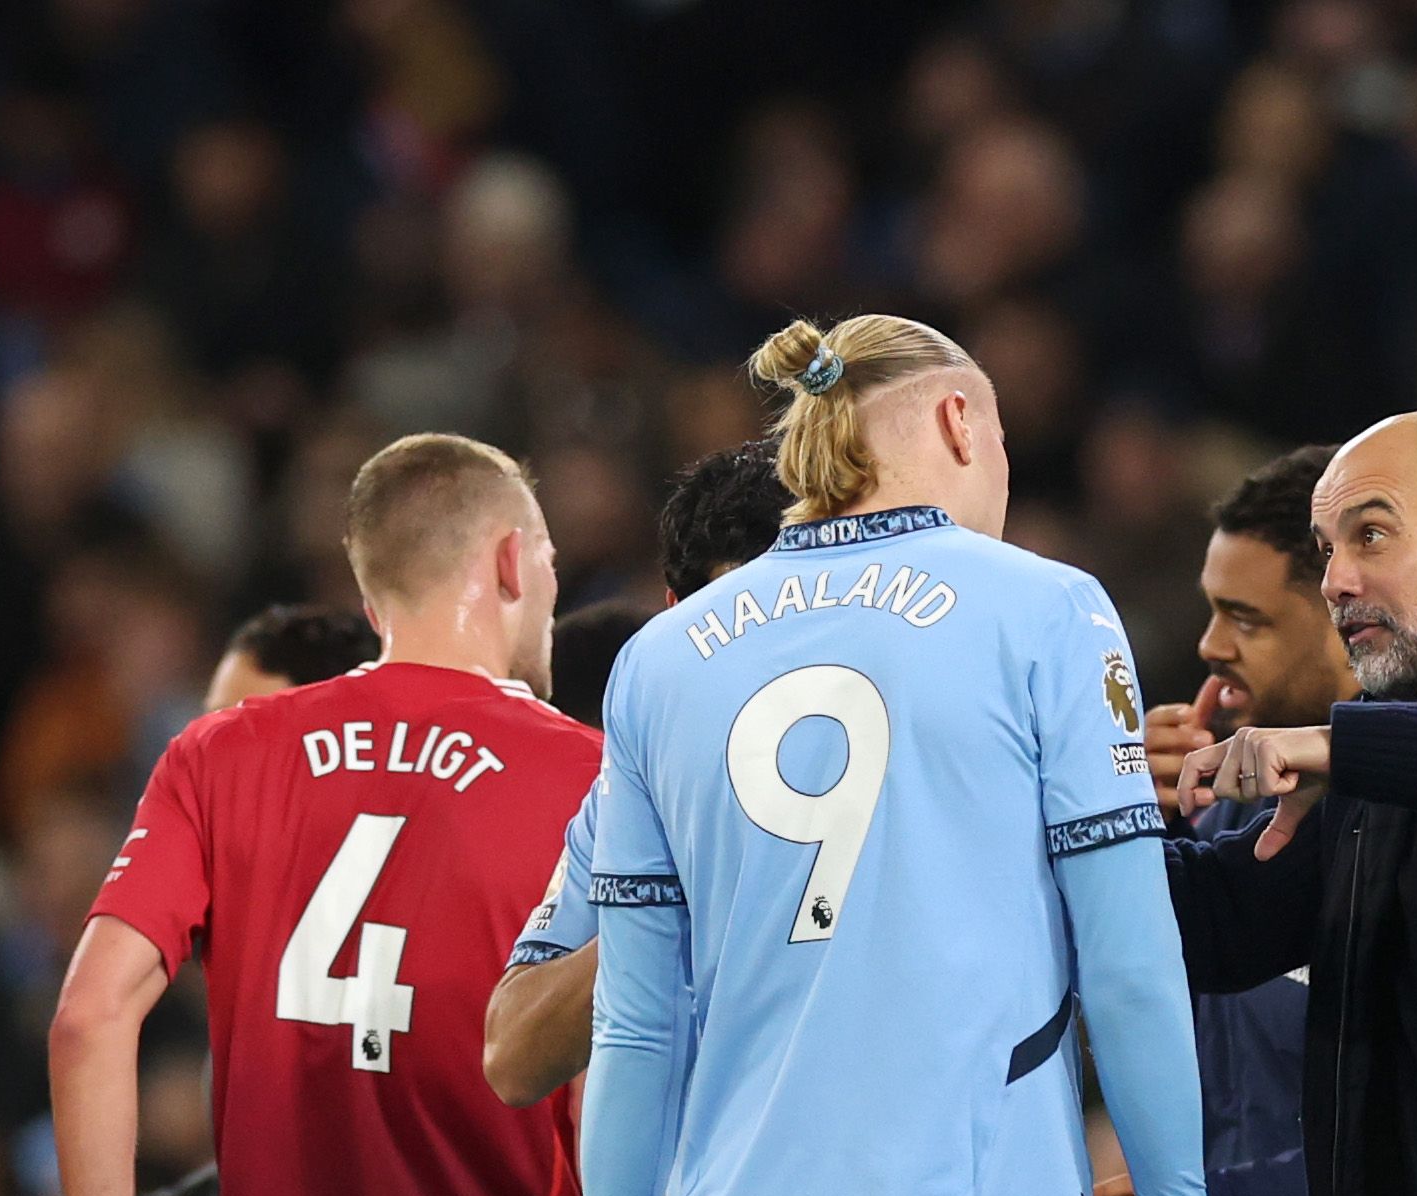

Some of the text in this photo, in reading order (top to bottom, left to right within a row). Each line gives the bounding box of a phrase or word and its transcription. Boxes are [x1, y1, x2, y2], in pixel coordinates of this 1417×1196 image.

[685, 563, 957, 660] HAALAND
[303, 722, 504, 792] DE LIGT
[726, 664, 890, 943] 9
[276, 812, 414, 1073] 4
